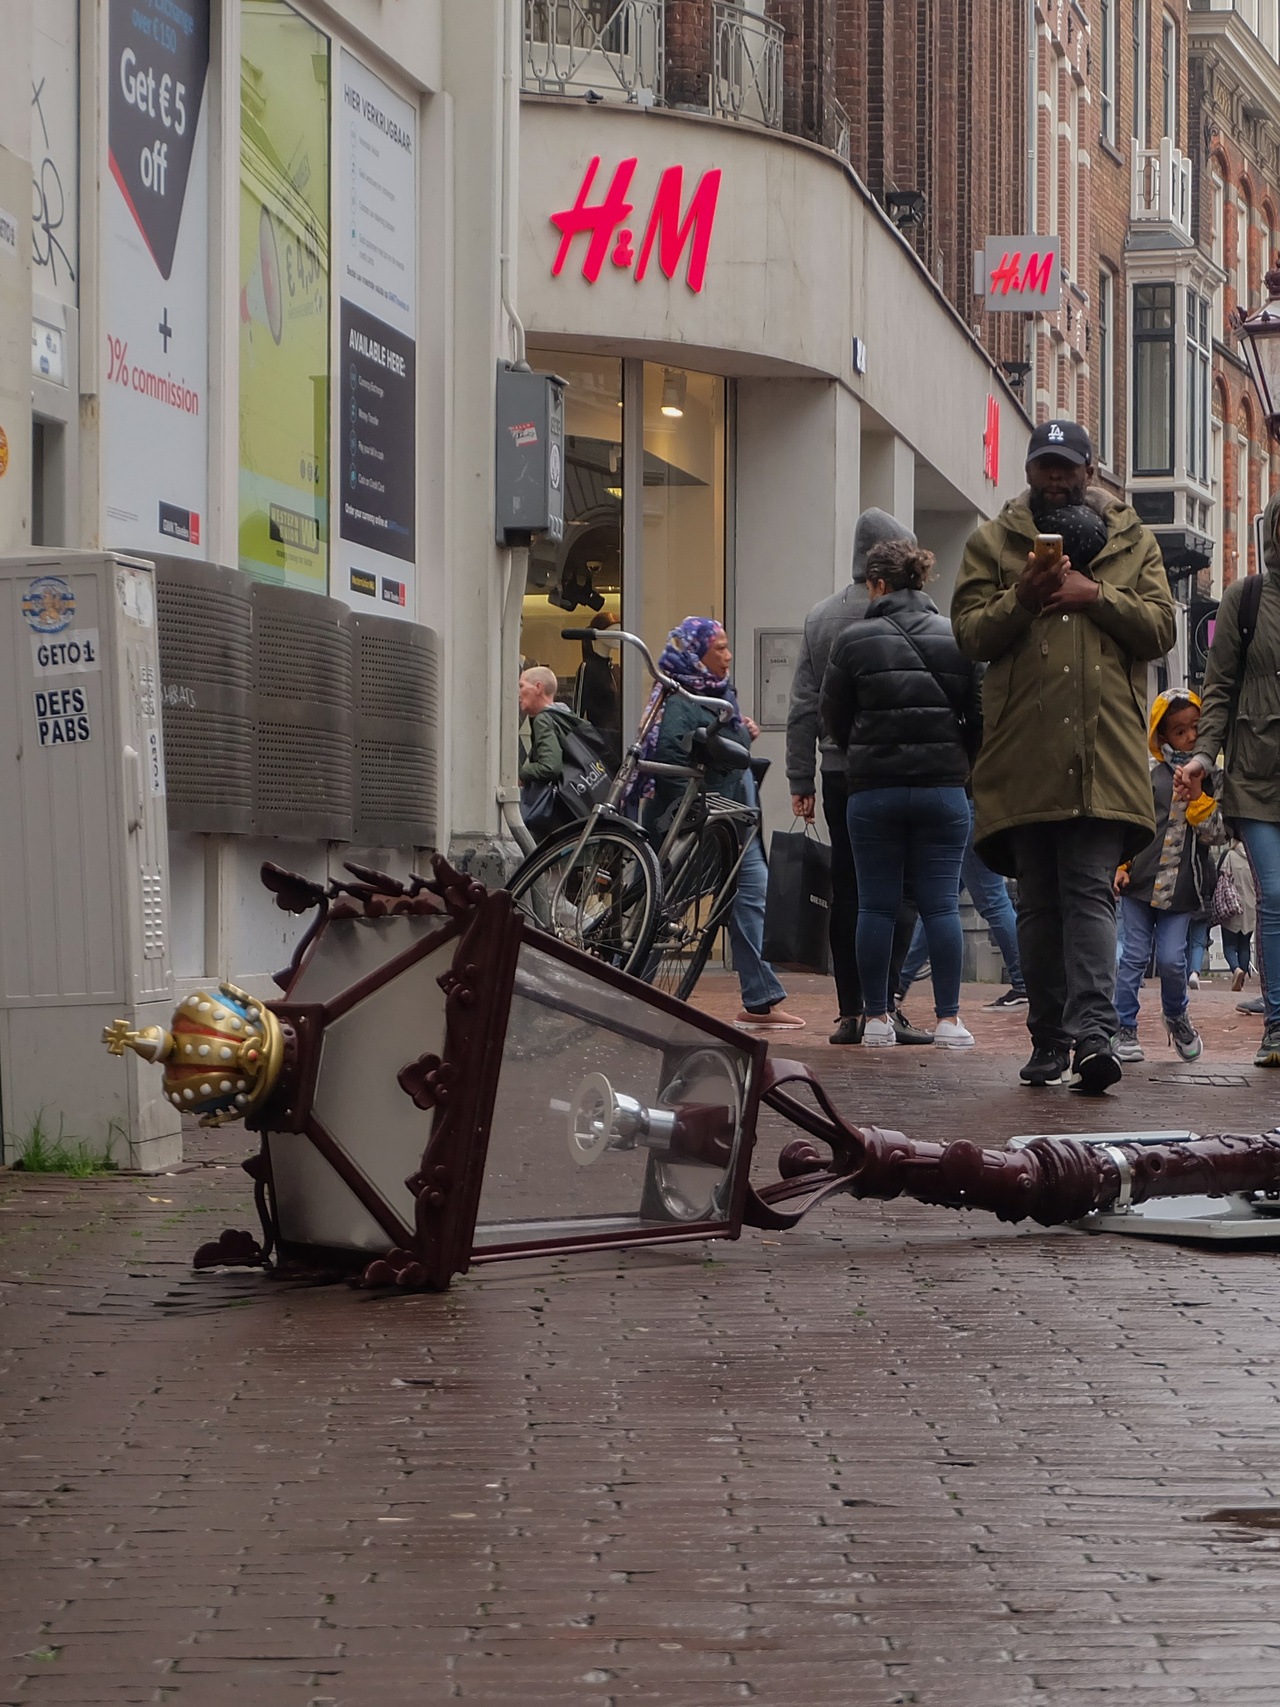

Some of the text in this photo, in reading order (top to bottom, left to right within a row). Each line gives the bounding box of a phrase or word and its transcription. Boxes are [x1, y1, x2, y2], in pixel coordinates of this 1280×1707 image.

[120, 47, 156, 118] Get
[344, 83, 361, 113] HIER
[140, 139, 168, 196] off
[550, 155, 722, 293] H&M
[989, 250, 1054, 296] H&M
[349, 328, 386, 367] AVAILABLE
[132, 372, 199, 416] commission
[270, 507, 299, 525] WESTERN
[35, 688, 84, 717] DEFS
[39, 716, 90, 745] PABS
